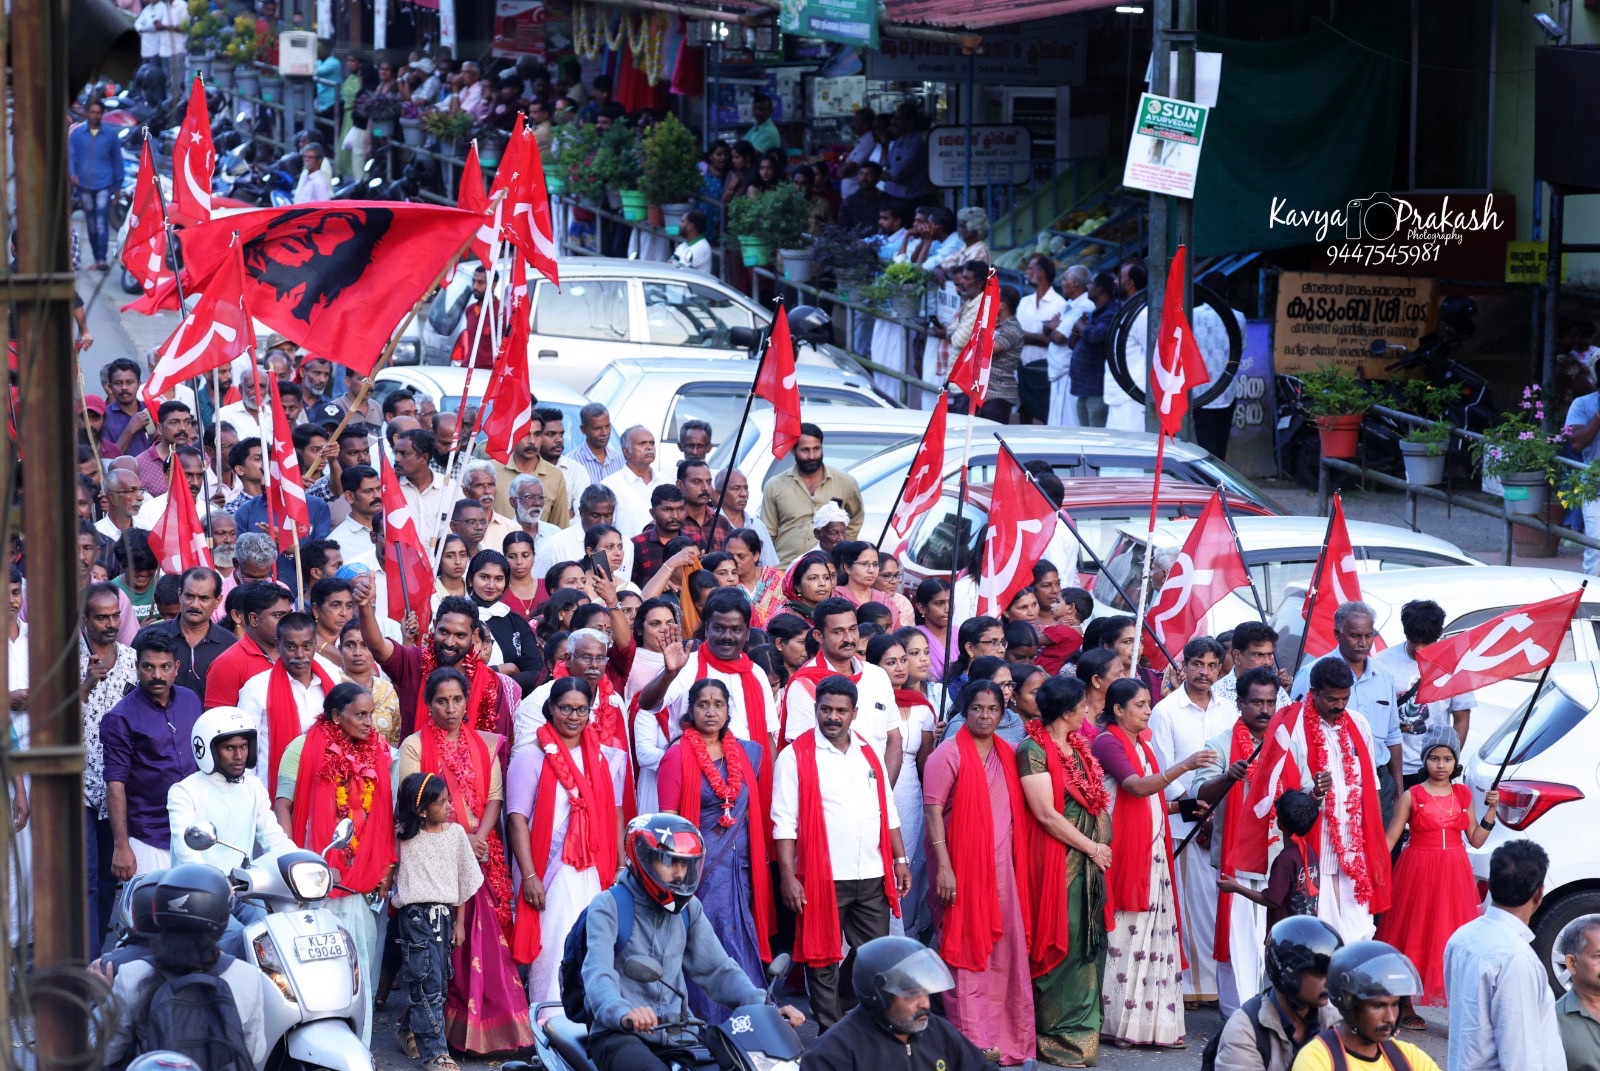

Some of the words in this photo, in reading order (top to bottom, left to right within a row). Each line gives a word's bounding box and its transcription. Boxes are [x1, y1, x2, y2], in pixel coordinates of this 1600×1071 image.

[1162, 102, 1200, 122] SUN
[1145, 113, 1197, 130] AYURVEDAM
[308, 934, 337, 947] KL73
[308, 945, 343, 958] C9048
